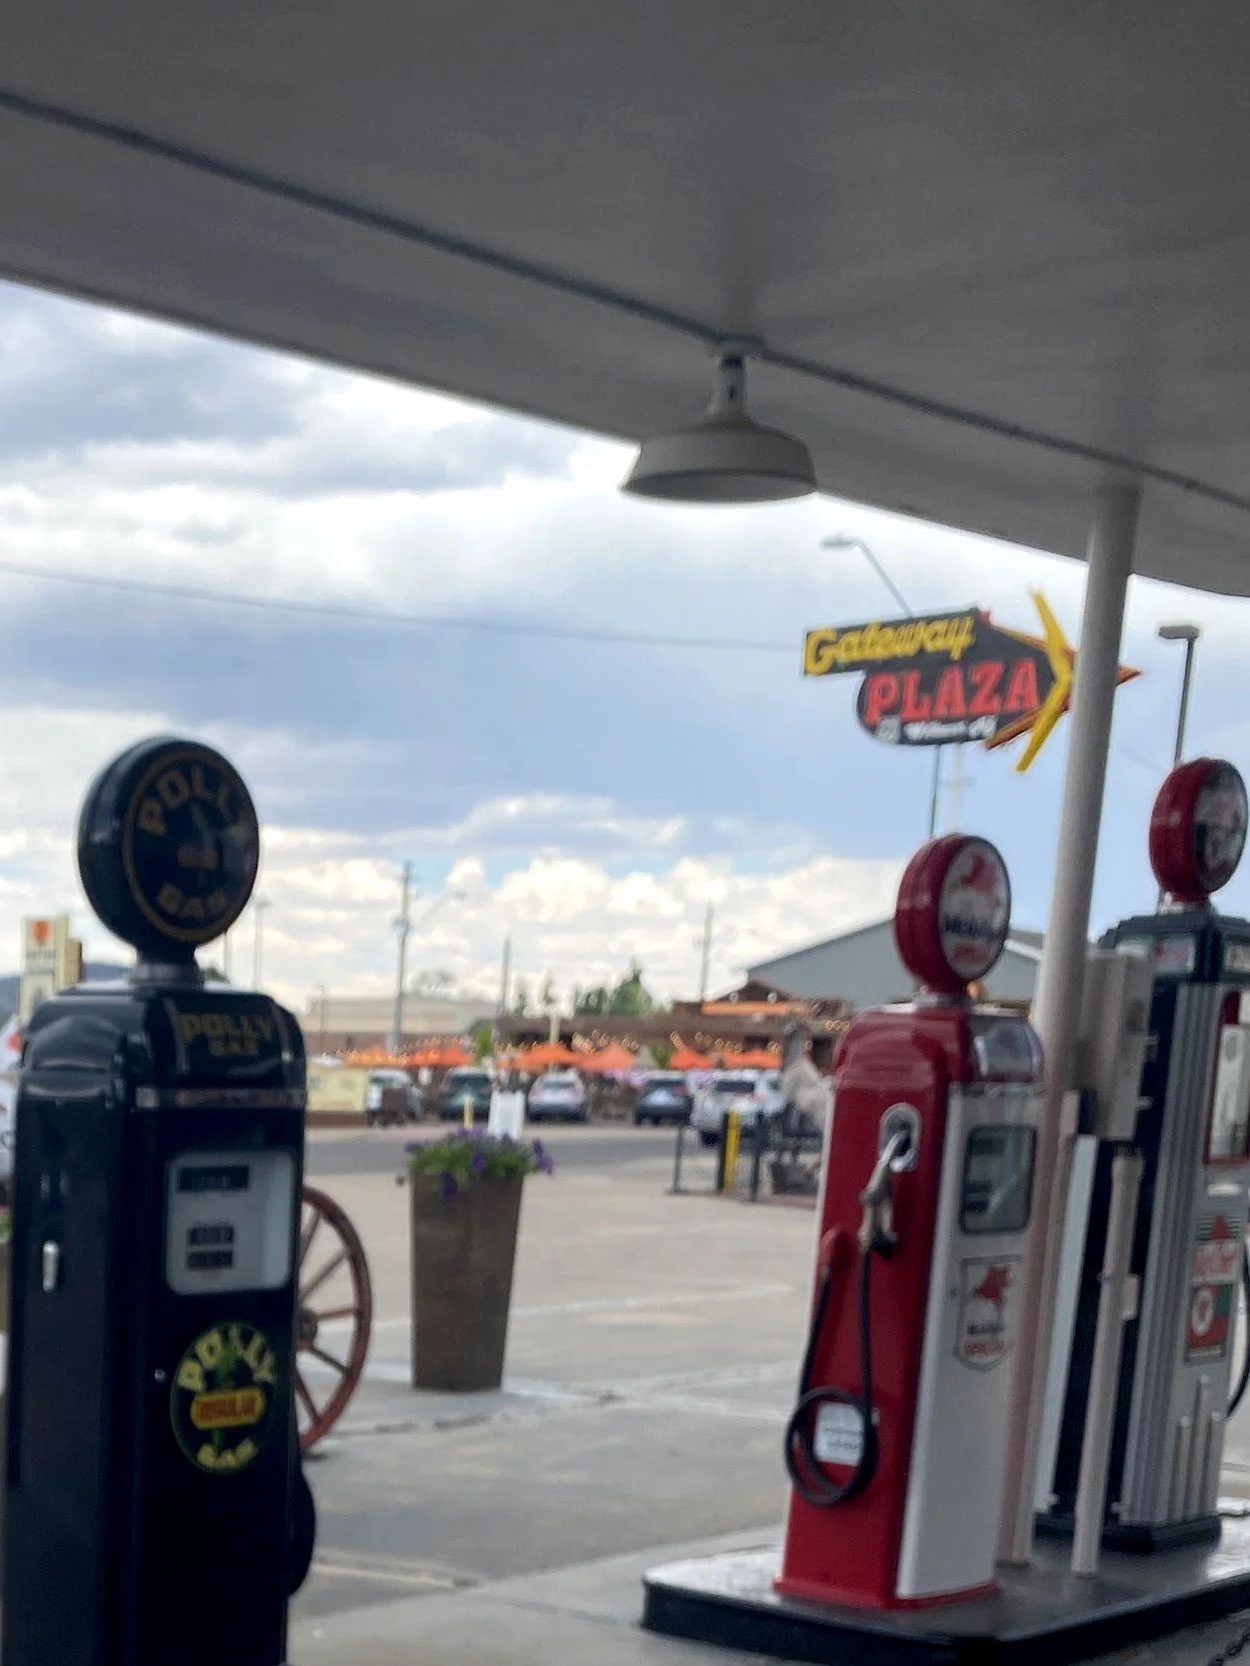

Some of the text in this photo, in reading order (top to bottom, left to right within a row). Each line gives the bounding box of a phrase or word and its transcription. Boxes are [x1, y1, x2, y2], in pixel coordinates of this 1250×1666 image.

[805, 615, 976, 676] Gateway
[864, 657, 1039, 727] PLAZA
[138, 764, 248, 838] POLL
